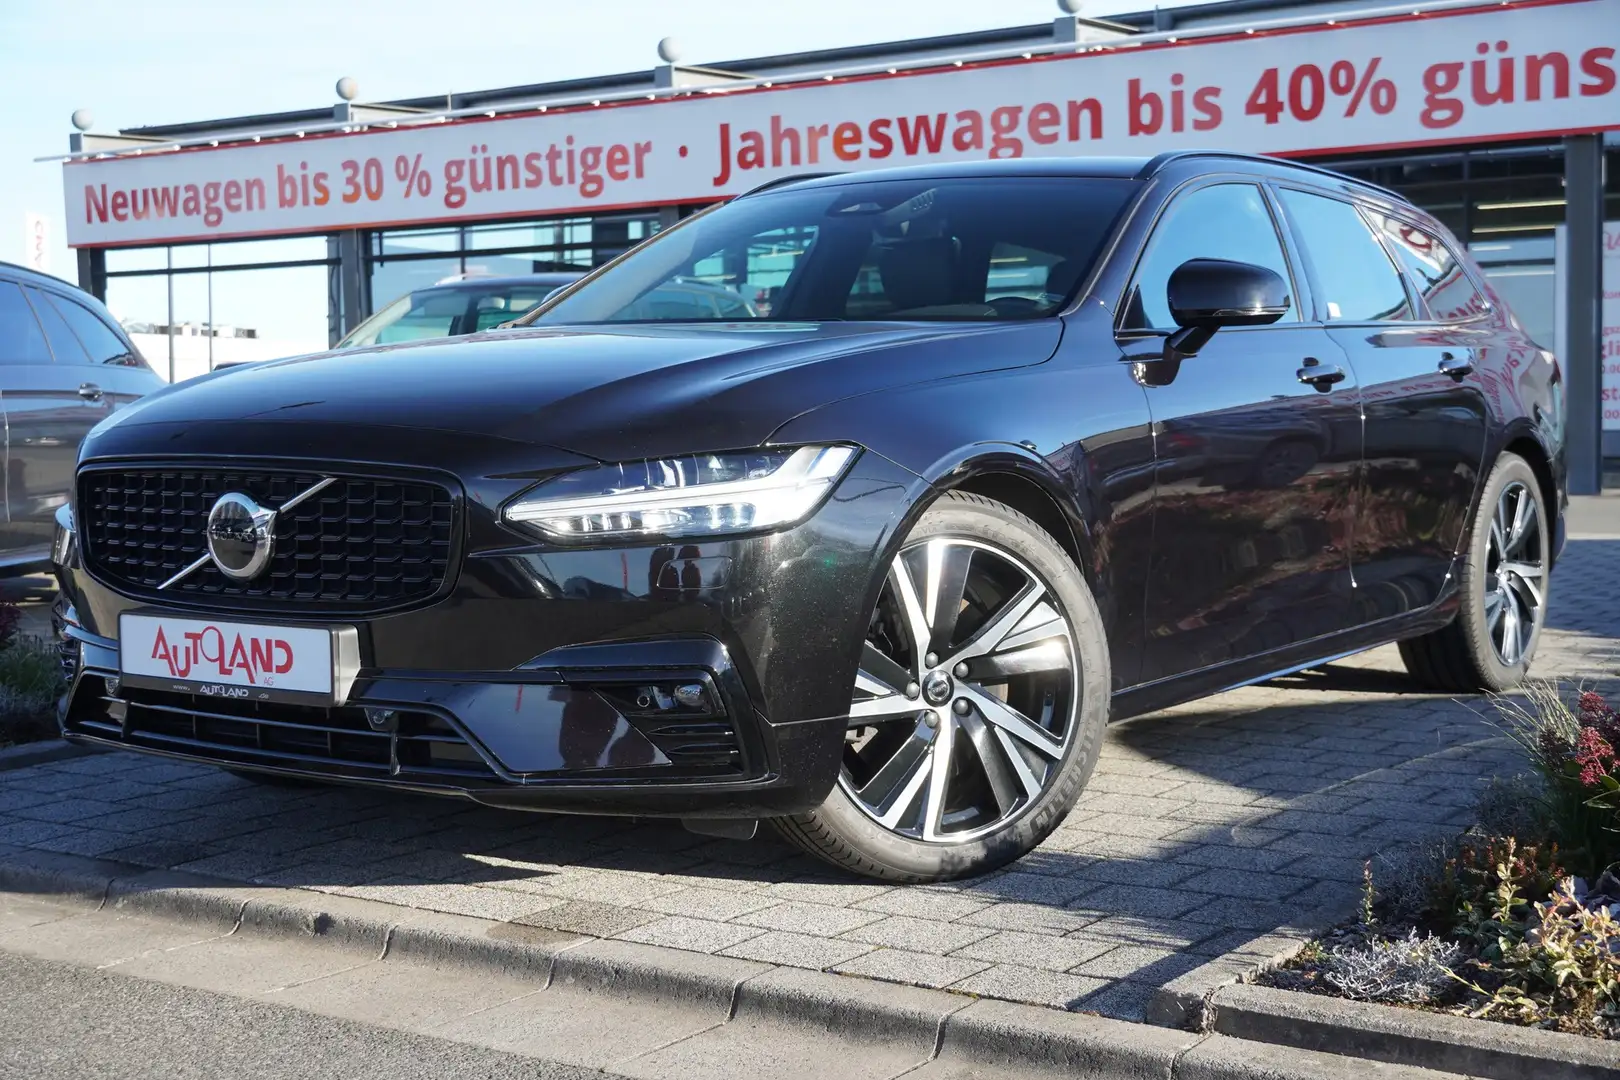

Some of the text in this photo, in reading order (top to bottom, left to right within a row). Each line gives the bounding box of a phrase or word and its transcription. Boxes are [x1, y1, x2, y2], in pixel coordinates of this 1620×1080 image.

[84, 41, 1616, 228] Neuwagen bis 30 % günstiger Jahreswagen bis 40% güns
[151, 624, 294, 684] AUTOLAND
[263, 676, 275, 687] AG
[199, 684, 249, 698] AUTOLAND
[1034, 717, 1098, 830] MICHELIN
